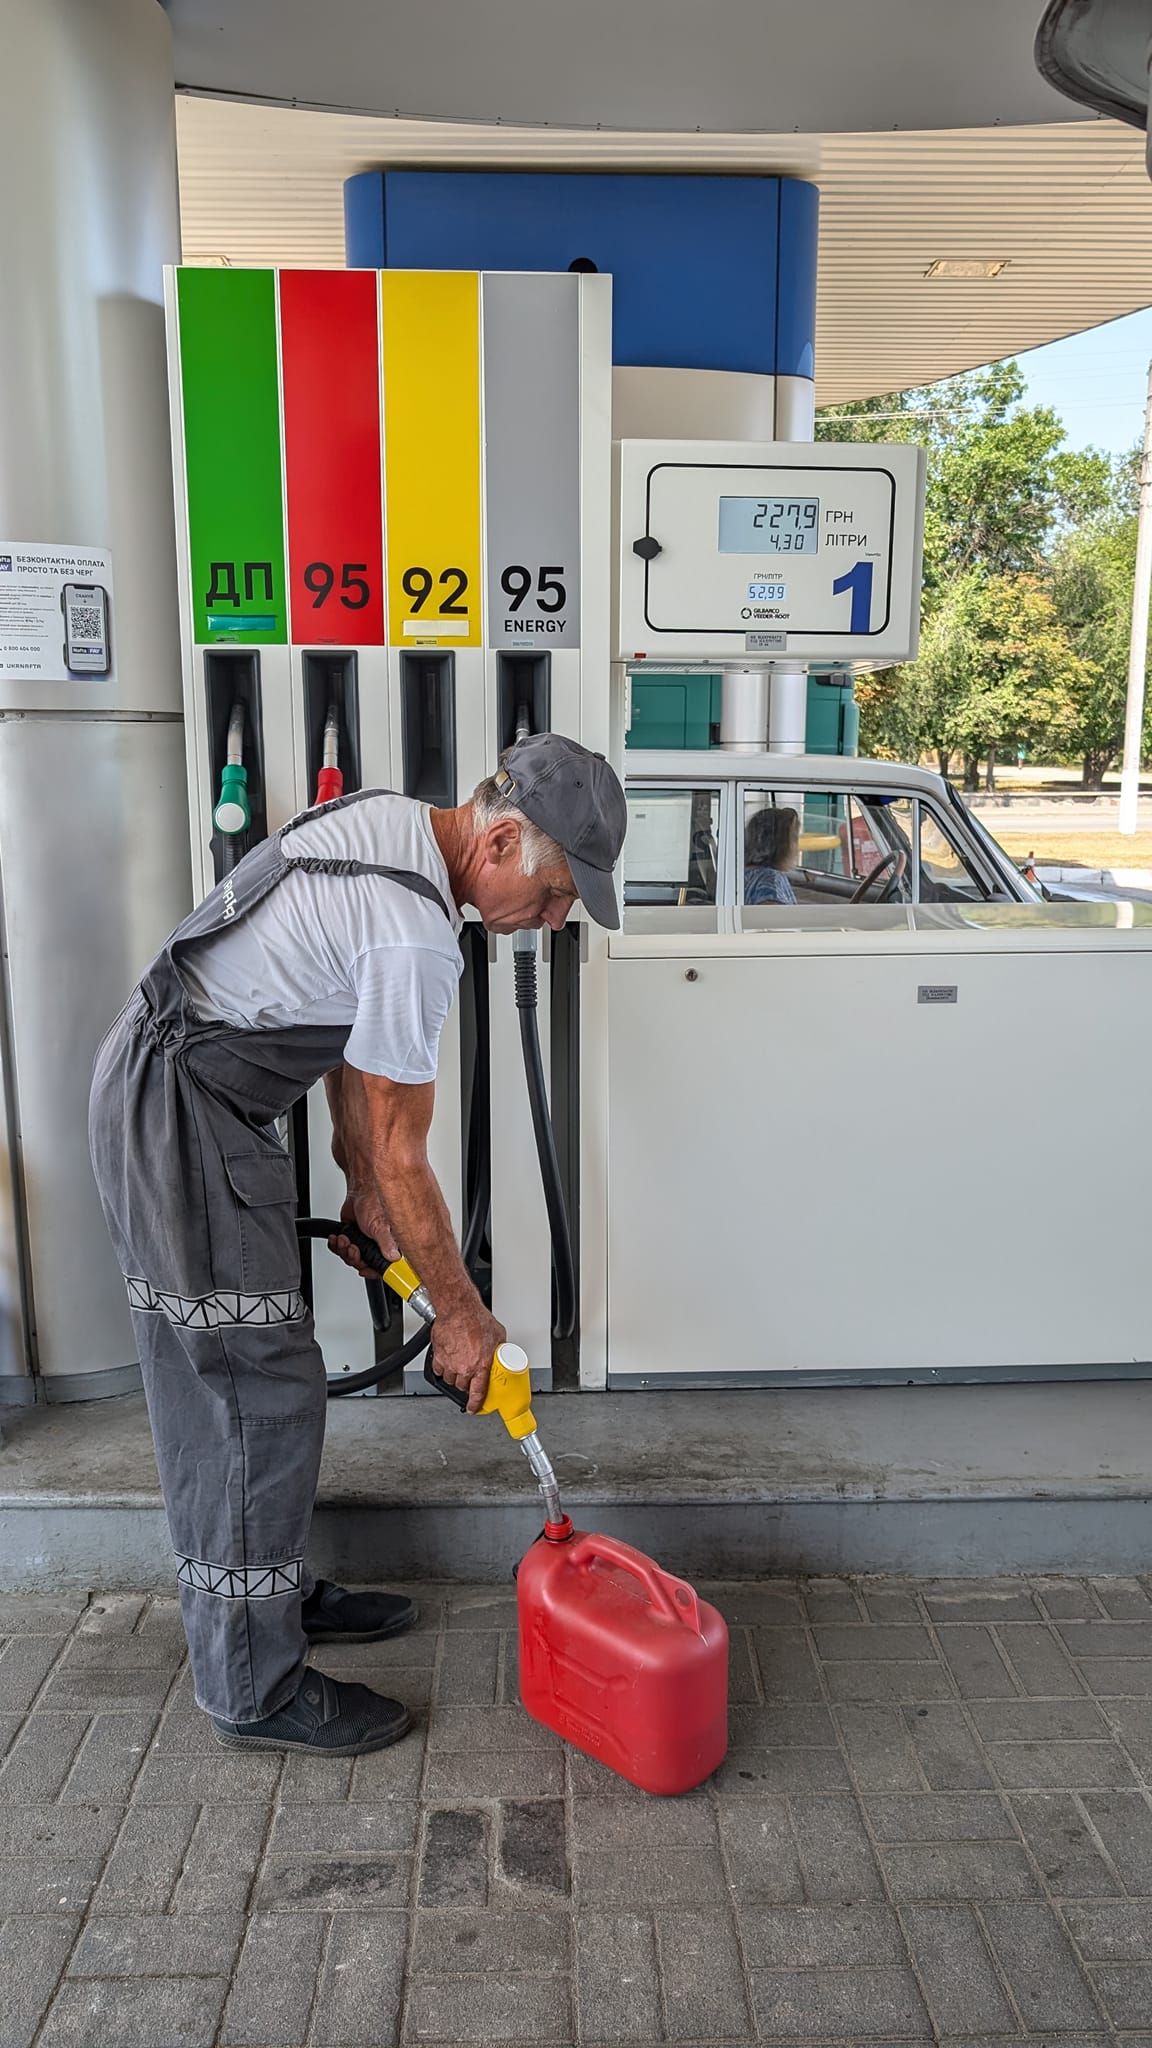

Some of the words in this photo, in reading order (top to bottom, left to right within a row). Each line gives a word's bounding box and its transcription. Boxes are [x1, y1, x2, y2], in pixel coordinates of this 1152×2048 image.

[753, 503, 817, 530] 227,9
[825, 511, 853, 523] ГРН
[770, 534, 804, 551] 4,30
[825, 534, 867, 547] ЛІТРИ
[16, 556, 76, 565] БЕЗКОНТАКТНА
[206, 562, 273, 607] ДП
[304, 562, 370, 609] 95
[402, 566, 469, 614] 92
[500, 566, 567, 613] 95
[749, 586, 785, 600] 52,99
[833, 561, 873, 633] 1
[504, 619, 567, 633] ENERGY
